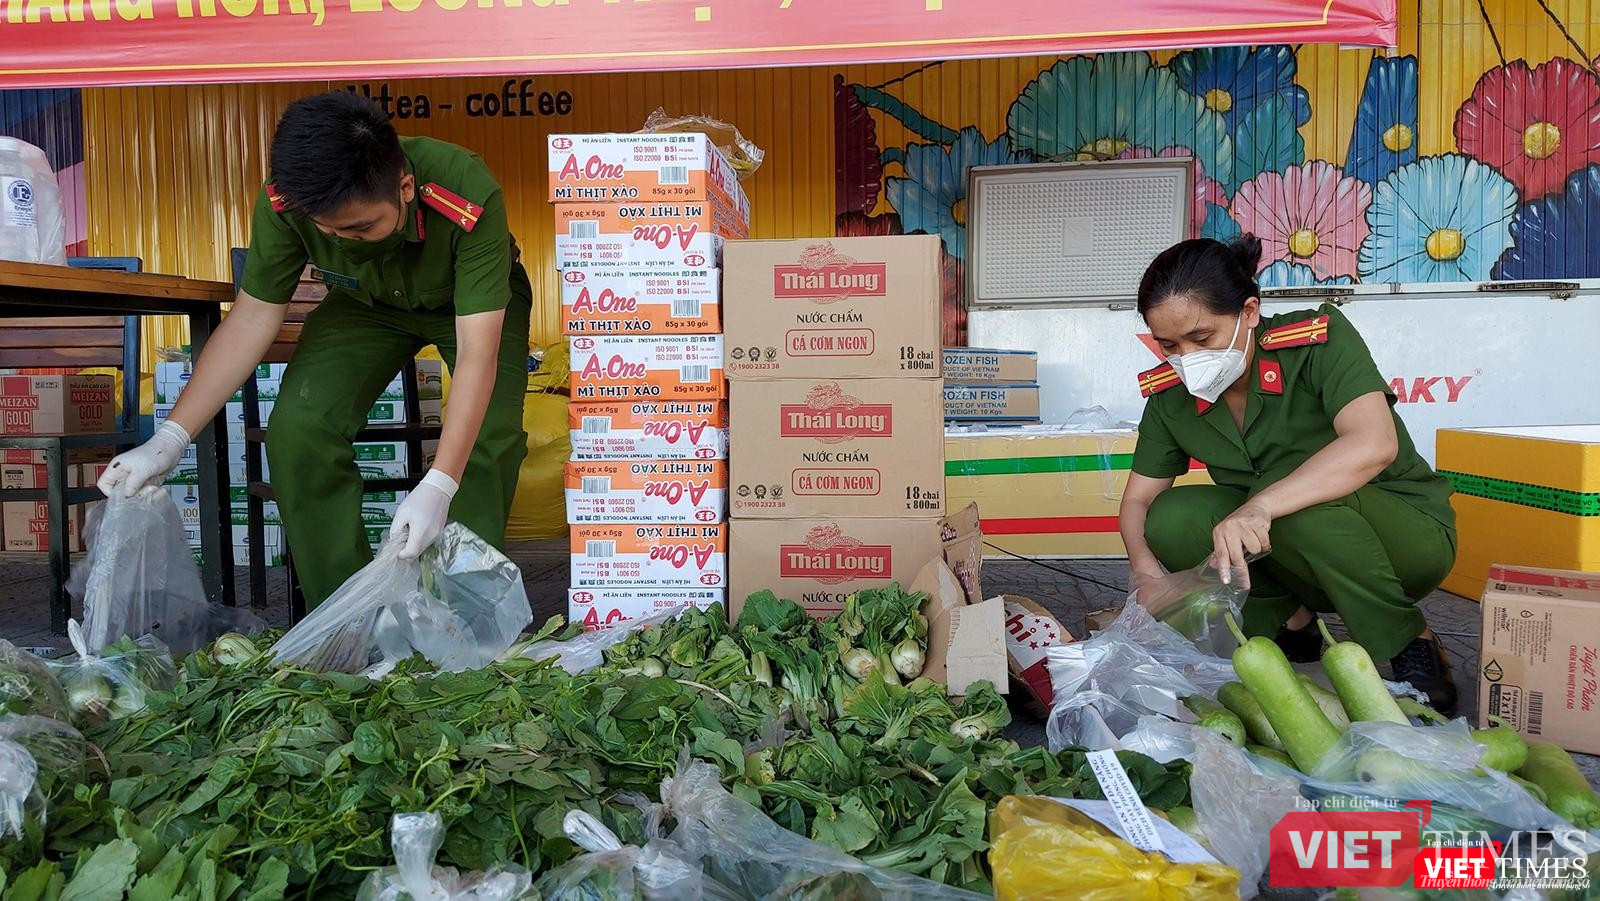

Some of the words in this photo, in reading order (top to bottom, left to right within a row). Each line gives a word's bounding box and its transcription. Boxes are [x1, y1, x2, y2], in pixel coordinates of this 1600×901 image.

[466, 79, 573, 117] coffee
[560, 154, 624, 180] A-One
[555, 184, 572, 197] MÌ
[576, 188, 607, 200] THỊT
[612, 184, 638, 197] XÀO
[619, 207, 645, 220] XÀO
[650, 205, 681, 216] THỊT
[686, 207, 701, 219] MÌ
[634, 224, 697, 250] A-One
[781, 272, 824, 289] Thái
[830, 272, 880, 291] Long
[572, 287, 636, 313] A-One
[797, 312, 827, 324] NƯỚC
[830, 309, 863, 323] CHẤM
[569, 317, 586, 330] MÌ
[590, 321, 620, 333] THỊT
[625, 317, 651, 330] XÀO
[665, 321, 679, 329] 85g
[792, 335, 806, 351] CÁ
[810, 335, 833, 350] CƠM
[837, 337, 868, 350] NGON
[900, 346, 914, 360] 18
[917, 351, 933, 360] chai
[582, 353, 646, 379] A-One
[908, 360, 934, 370] 800ml
[944, 356, 972, 364] OZEN
[976, 356, 998, 365] FISH
[578, 384, 593, 396] MÌ
[599, 386, 629, 398] THỊT
[634, 383, 660, 395] XÀO
[981, 391, 1005, 400] FISH
[1389, 376, 1473, 403] AKY
[0, 398, 37, 407] MEIZAN
[662, 402, 692, 414] THỊT
[80, 405, 102, 419] GOLD
[632, 404, 658, 417] XÀO
[697, 404, 712, 417] MÌ
[6, 411, 30, 425] GOLD
[788, 412, 831, 429] Thái
[836, 413, 885, 431] Long
[644, 421, 707, 445] A-One
[803, 451, 833, 463] NƯỚC
[836, 449, 869, 462] CHẤM
[632, 465, 658, 477] XÀO
[662, 462, 692, 474] THỊT
[697, 464, 712, 477] MÌ
[799, 474, 812, 490] CÁ
[816, 475, 839, 490] CƠM
[843, 476, 873, 490] NGON
[645, 481, 708, 506] A-One
[906, 486, 920, 499] 18
[923, 490, 939, 499] chai
[913, 500, 939, 509] 800ml
[637, 528, 663, 541] XÀO
[667, 524, 697, 537] THỊT
[702, 527, 718, 540] MÌ
[650, 545, 714, 570] A-One
[788, 553, 830, 569] Thái
[836, 553, 885, 573] Long
[802, 592, 833, 603] NƯỚC
[1502, 692, 1511, 702] 12
[1110, 762, 1130, 795] COVID-19
[1119, 811, 1129, 824] AN
[1127, 809, 1137, 822] TAY
